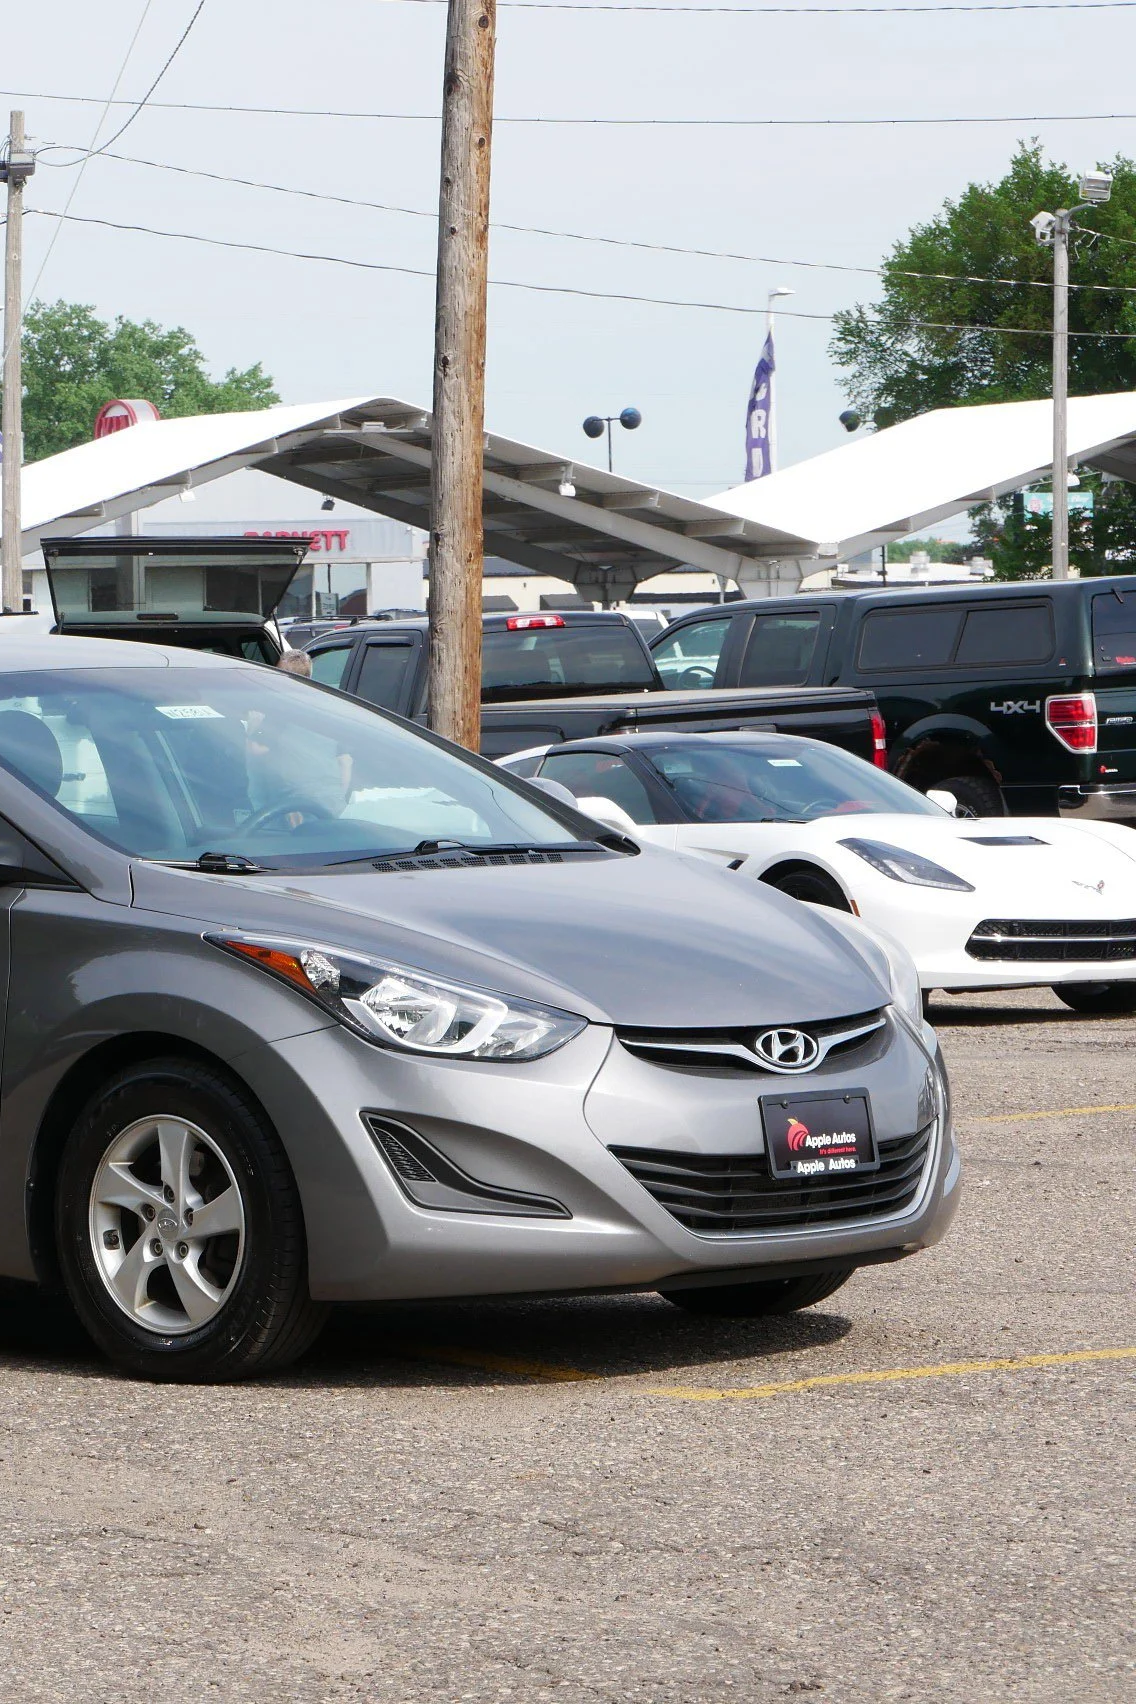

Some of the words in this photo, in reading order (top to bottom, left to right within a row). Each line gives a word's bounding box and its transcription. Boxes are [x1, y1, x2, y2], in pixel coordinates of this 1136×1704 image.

[805, 1134, 831, 1148] Apple
[832, 1132, 856, 1144] Autos
[797, 1161, 824, 1175] Apple
[829, 1157, 856, 1170] Autos
